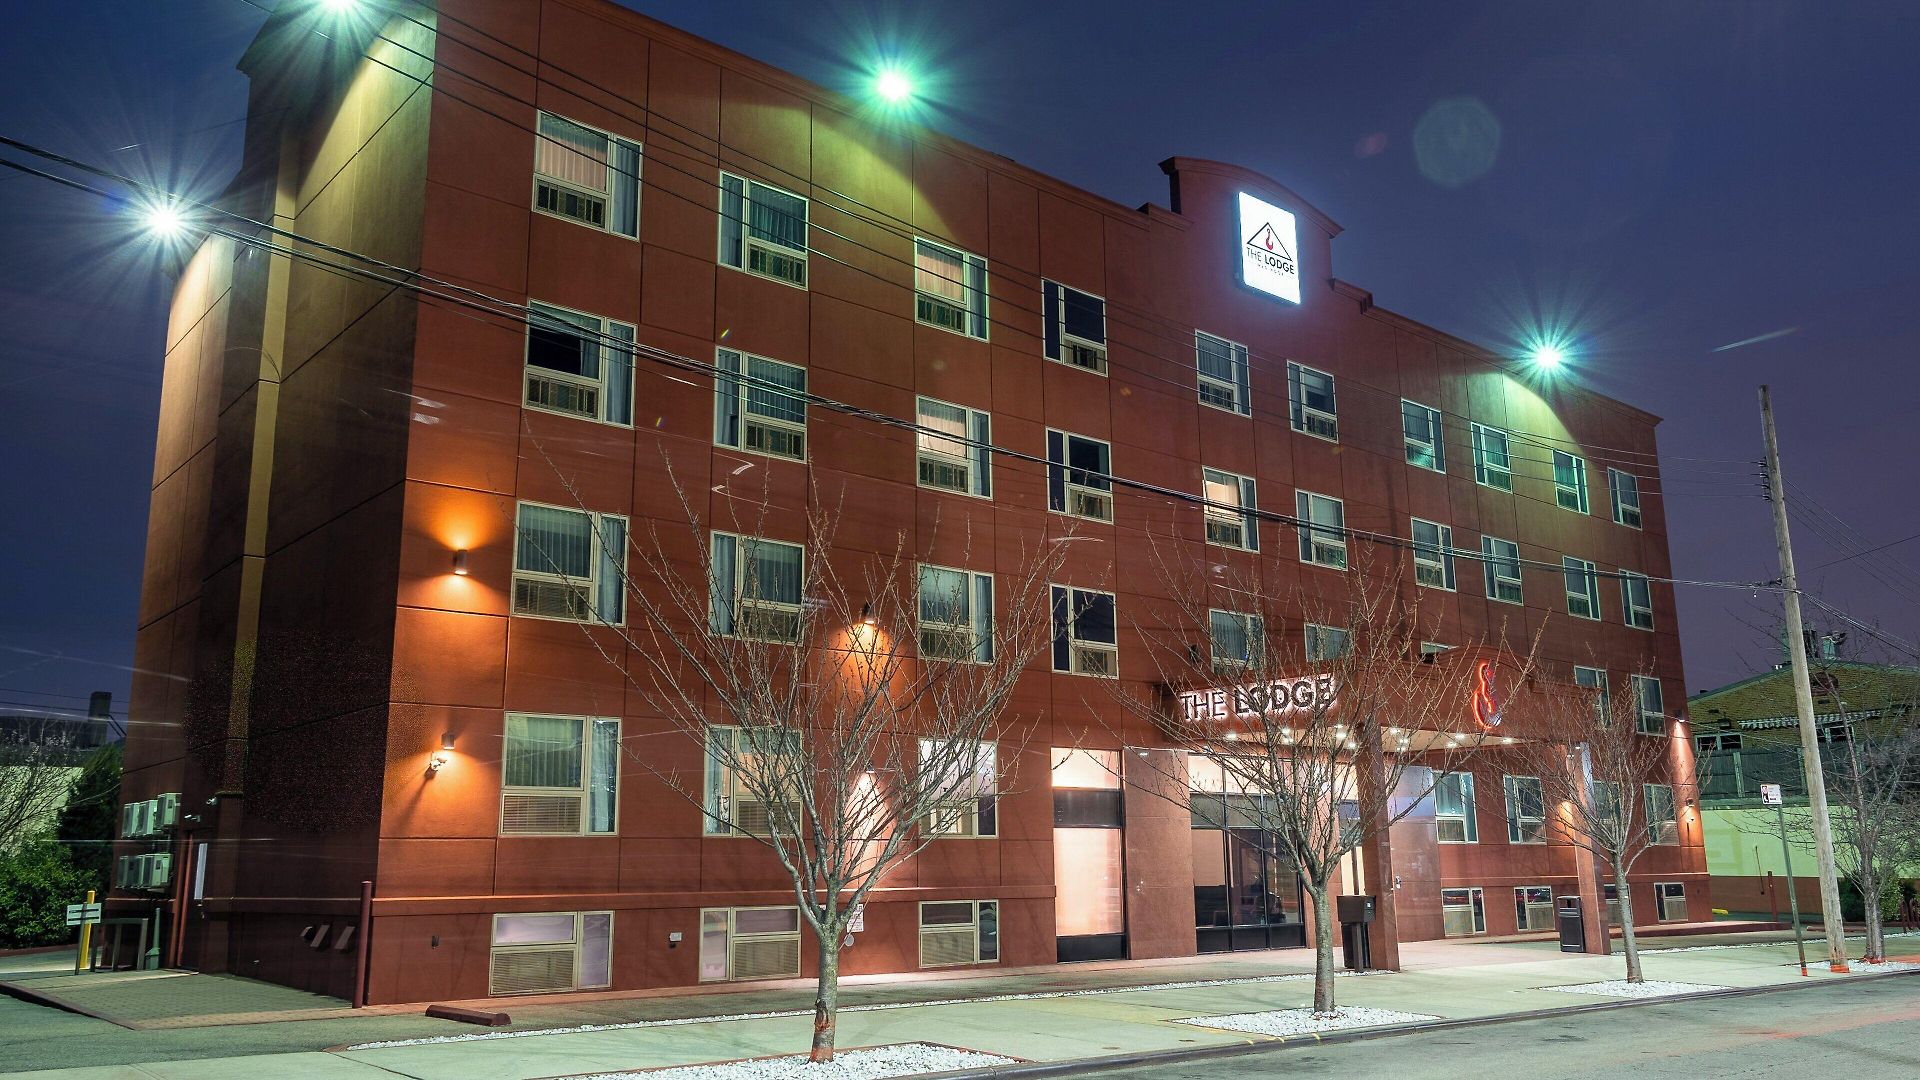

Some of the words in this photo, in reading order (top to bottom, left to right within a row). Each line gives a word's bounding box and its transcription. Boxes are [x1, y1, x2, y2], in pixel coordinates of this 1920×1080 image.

[1246, 246, 1262, 262] THE
[1265, 254, 1295, 275] LODGE
[1180, 691, 1226, 720] THE
[1235, 677, 1331, 714] LODGE
